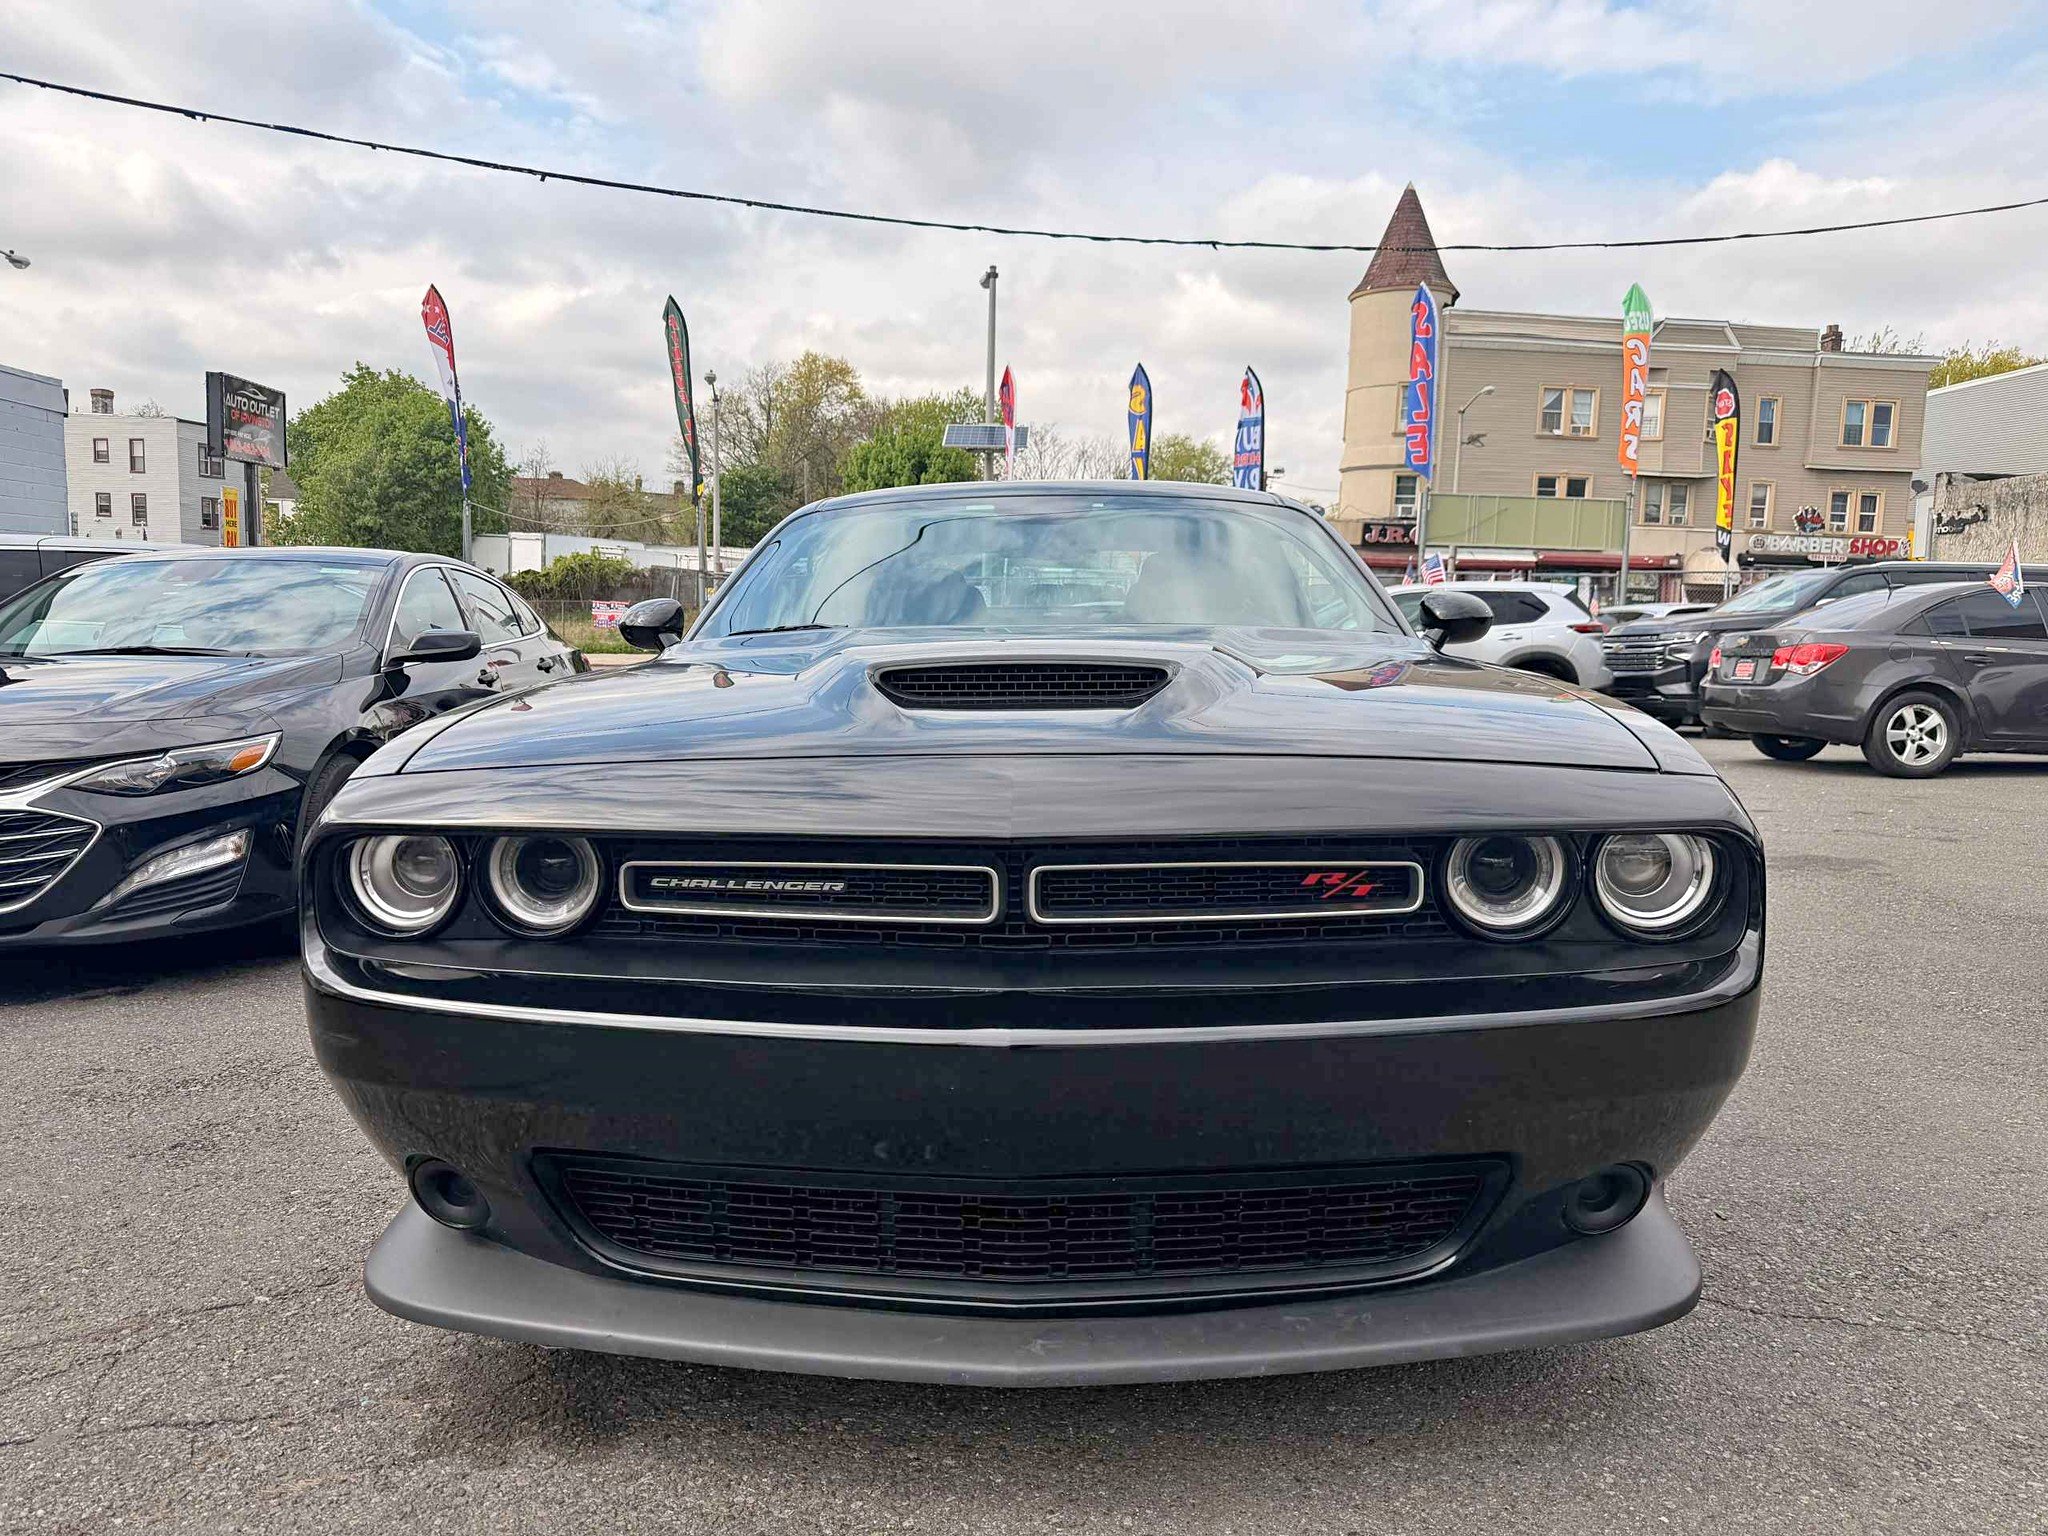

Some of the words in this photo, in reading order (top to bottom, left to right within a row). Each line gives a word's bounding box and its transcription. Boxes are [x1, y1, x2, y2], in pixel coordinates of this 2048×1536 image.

[225, 392, 249, 410] AUTO
[249, 398, 280, 419] OUTLET
[224, 498, 237, 519] BUY
[225, 519, 238, 528] HERE
[226, 530, 238, 548] PAY
[1768, 534, 1845, 555] BARBER
[1849, 537, 1899, 556] SHOP
[650, 877, 847, 892] CHALLENGER
[1301, 870, 1384, 898] R/T
